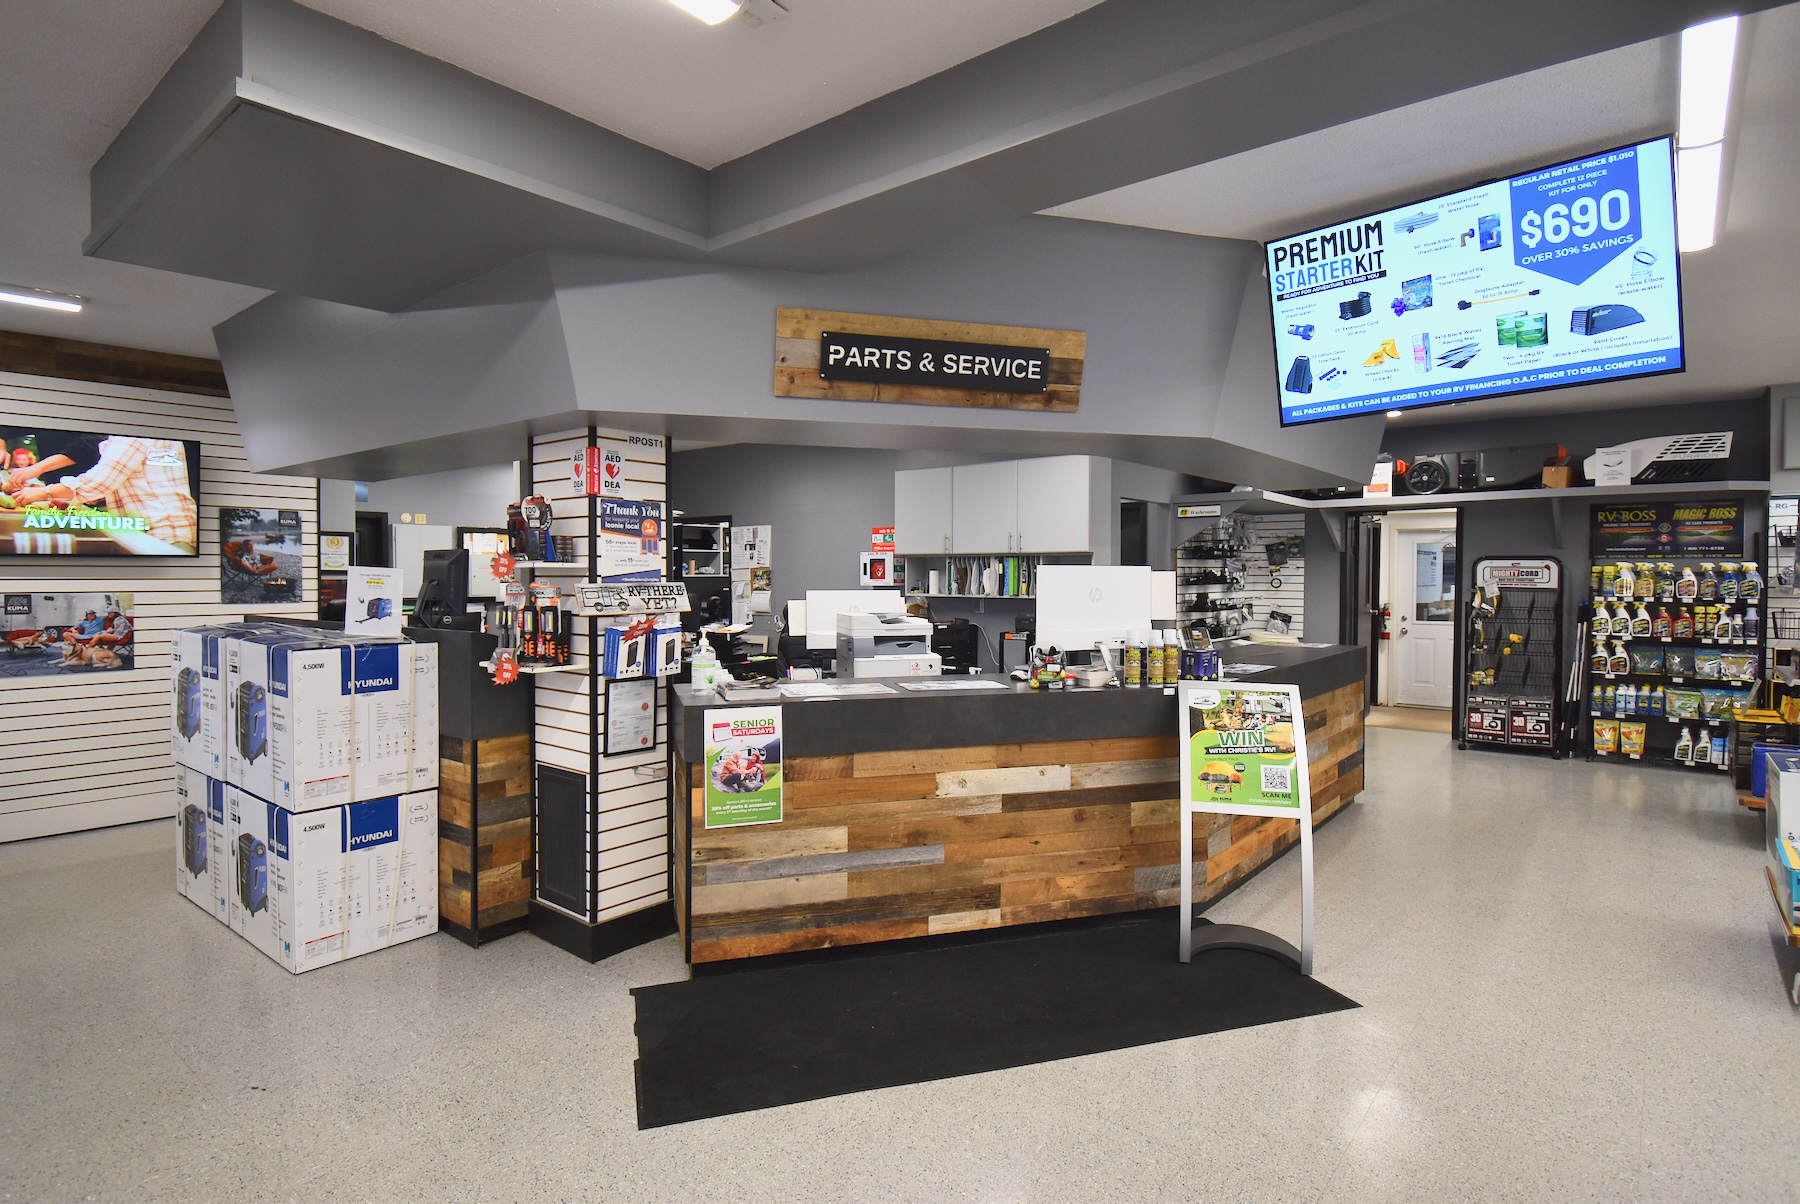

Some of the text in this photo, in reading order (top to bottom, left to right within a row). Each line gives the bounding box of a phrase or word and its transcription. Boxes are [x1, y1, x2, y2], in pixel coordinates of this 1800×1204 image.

[1512, 173, 1550, 187] REGULAR
[1551, 166, 1580, 178] RETAIL
[1582, 158, 1607, 170] PRICE
[1538, 177, 1576, 192] COMPLETE
[1586, 169, 1608, 180] PIECE
[1562, 186, 1576, 194] FOR
[1578, 180, 1598, 190] ONLY
[1520, 189, 1630, 248] $690
[1274, 220, 1384, 272] PREMIUM
[1522, 234, 1634, 264] OVER 30% SAVINGS
[1275, 250, 1384, 293] STARTER KIT
[1312, 280, 1344, 292] ADVENTURE
[828, 344, 1042, 380] PARTS & SERVICE
[1304, 404, 1340, 416] PACKAGES
[1348, 400, 1364, 409] KITS
[1364, 398, 1380, 406] CAN
[1392, 392, 1418, 402] ADDED
[1430, 388, 1452, 396] YOUR
[1453, 385, 1465, 393] RV
[1466, 378, 1511, 392] FINANCING
[1512, 374, 1538, 384] O.A.C
[1538, 370, 1565, 381] PRIOR
[1566, 368, 1579, 376] TO
[1580, 364, 1603, 375] DEAL
[1604, 355, 1666, 372] COMPLETION
[629, 436, 663, 448] RPOST1
[604, 454, 620, 462] AED
[602, 503, 660, 518] Thank You
[1598, 510, 1657, 522] RV BOSS
[1672, 507, 1737, 520] MAGIC BOSS
[24, 514, 150, 531] ADVENTURE.
[734, 718, 774, 728] SENIOR
[1470, 713, 1482, 722] 30
[1512, 716, 1524, 726] 30
[732, 727, 774, 736] SATURDAYS
[1218, 730, 1264, 747] WIN
[303, 823, 325, 832] 4,500W
